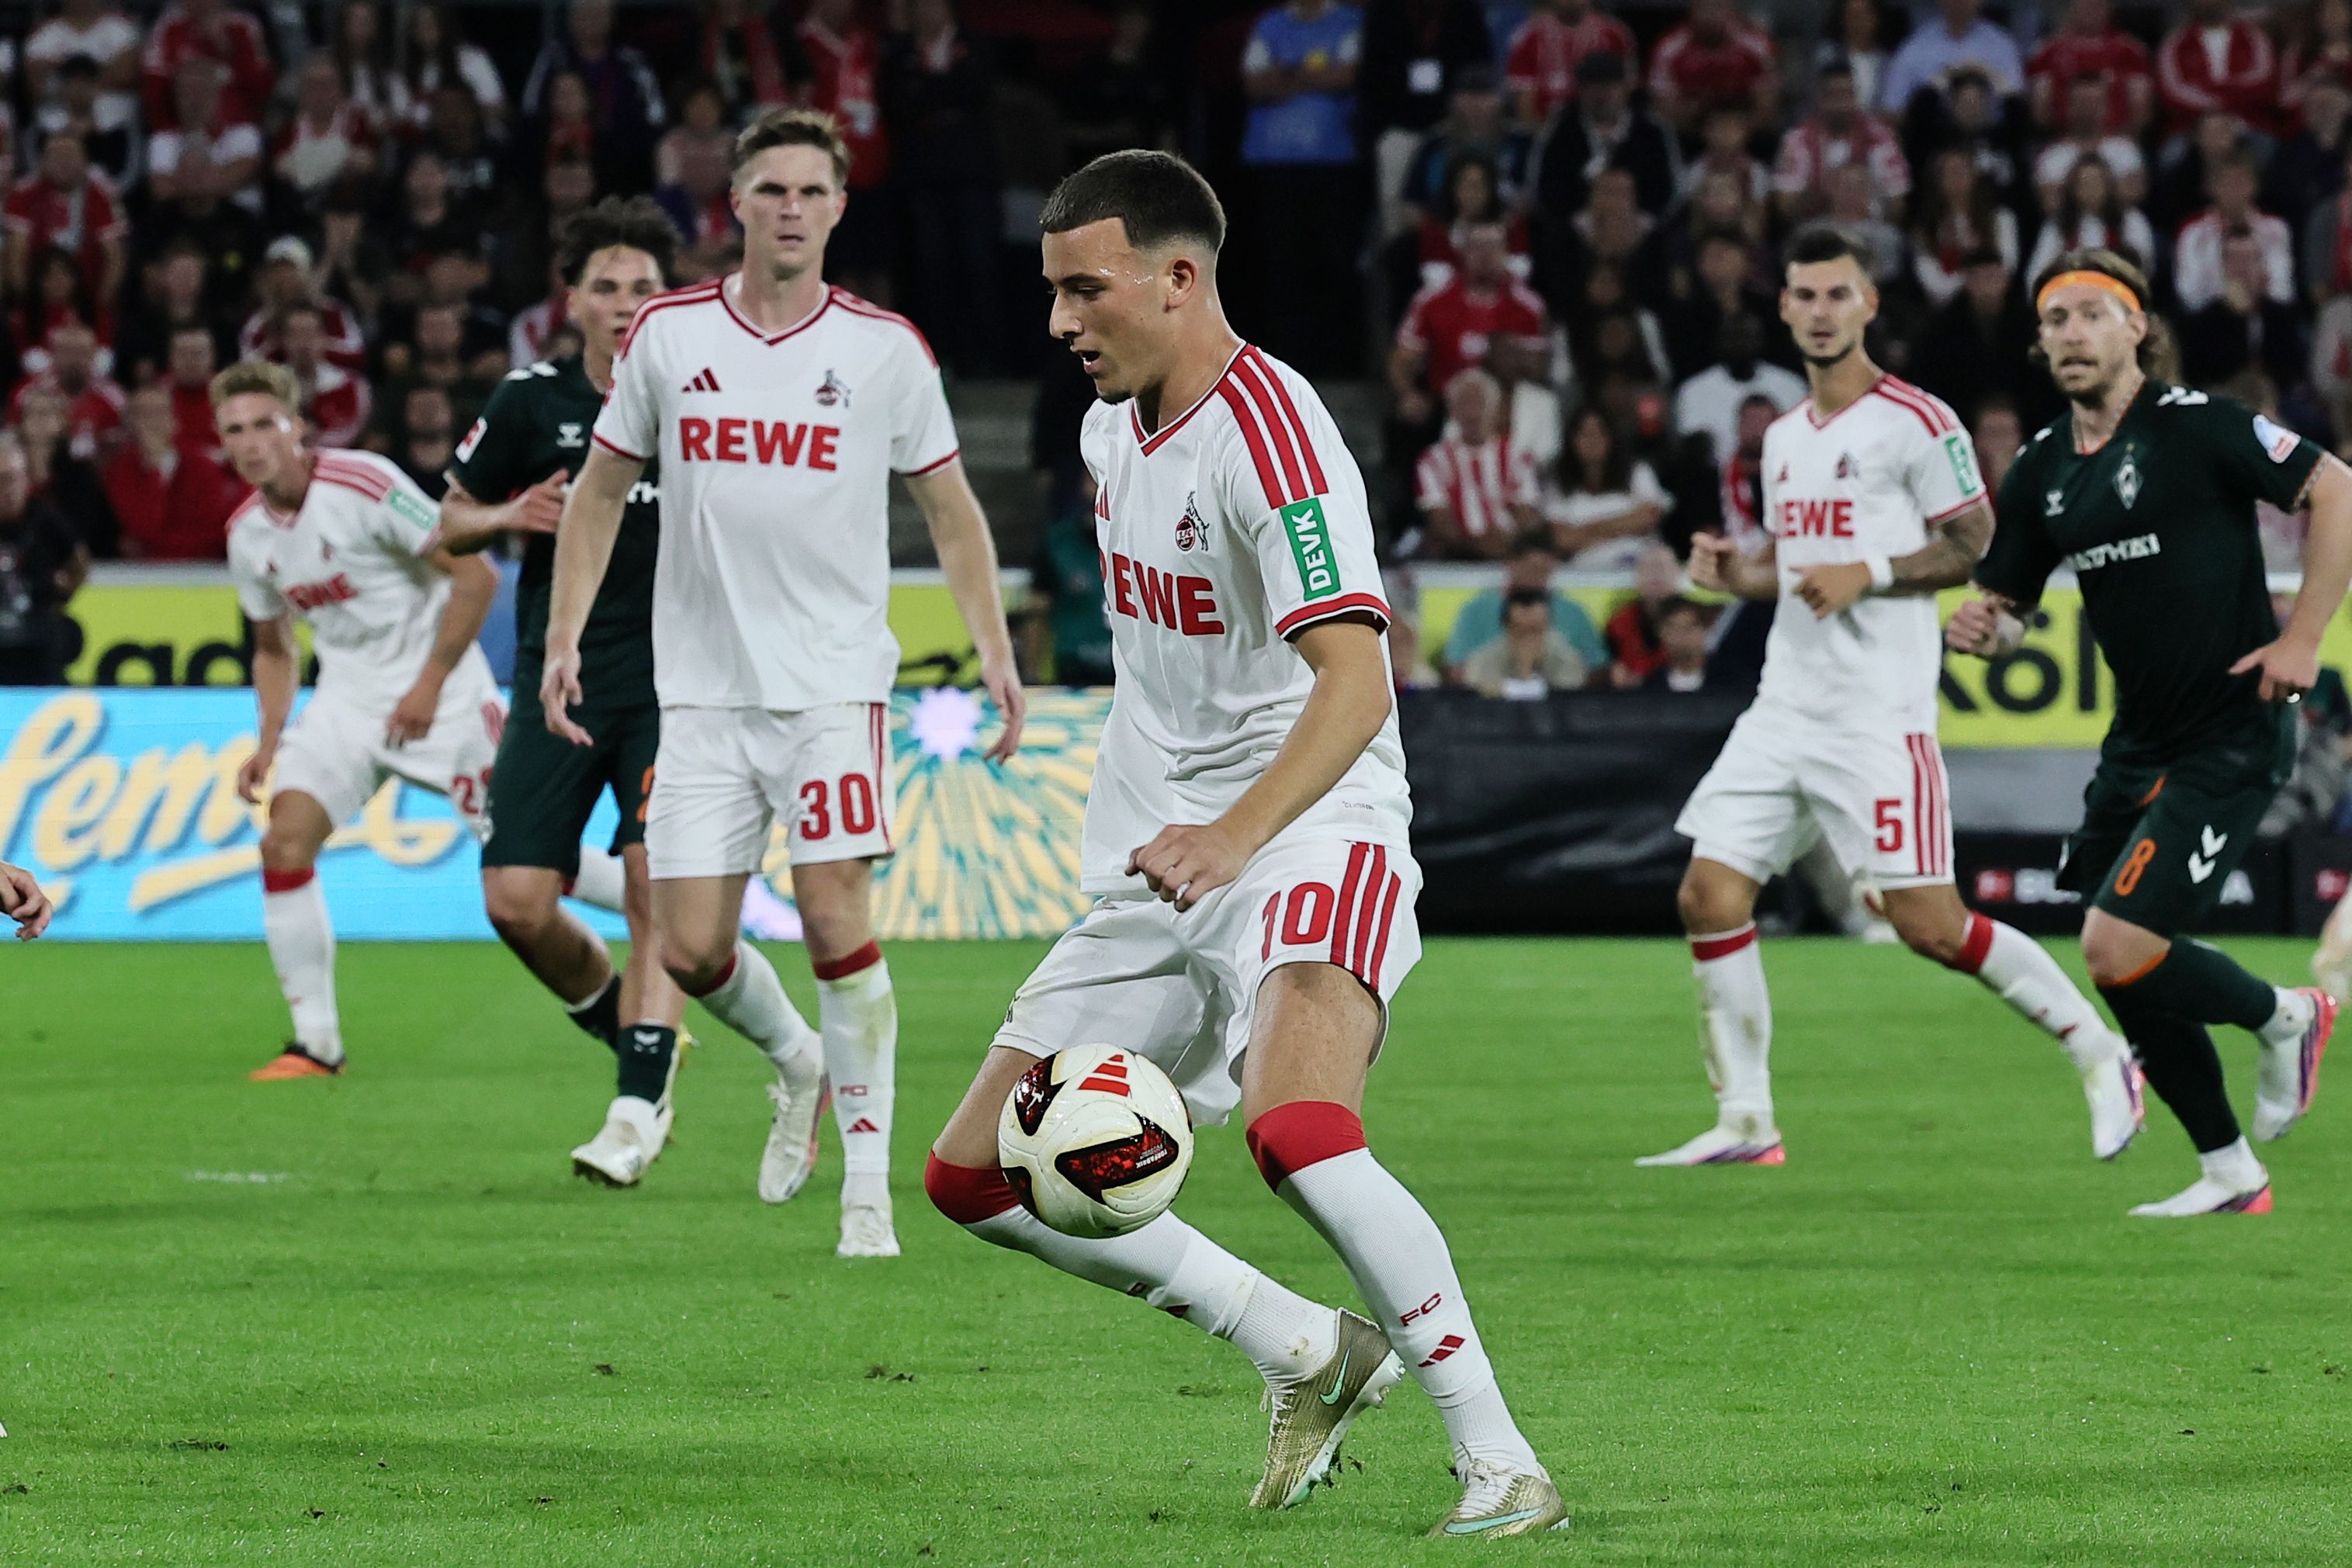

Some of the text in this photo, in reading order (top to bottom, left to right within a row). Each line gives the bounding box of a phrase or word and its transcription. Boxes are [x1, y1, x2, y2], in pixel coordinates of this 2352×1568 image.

[680, 417, 840, 471] REWE
[1290, 507, 1332, 592] DEVK
[799, 773, 875, 840] 30
[1875, 799, 1903, 852] 5
[2114, 838, 2156, 897] 8
[1261, 881, 1335, 963] 10
[1399, 1293, 1442, 1327] FC
